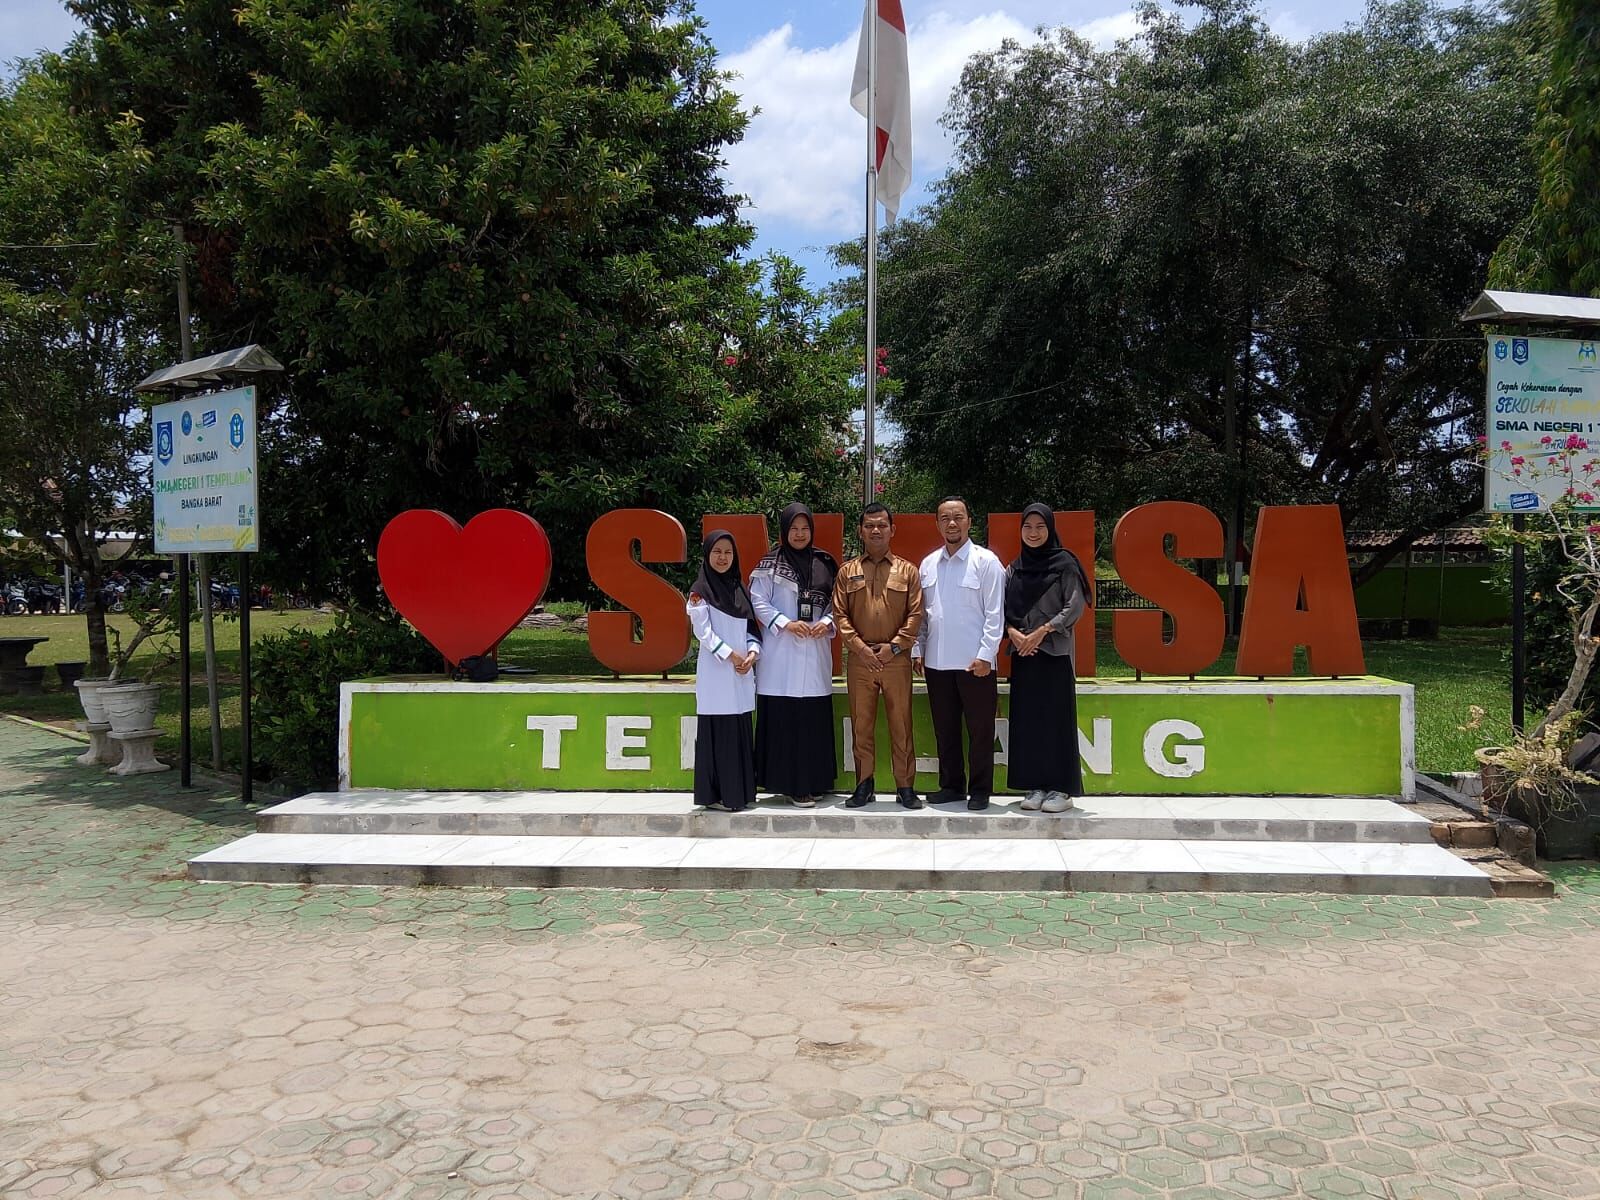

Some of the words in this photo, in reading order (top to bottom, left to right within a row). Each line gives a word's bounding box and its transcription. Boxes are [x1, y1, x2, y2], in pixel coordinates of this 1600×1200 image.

[1497, 381, 1518, 394] Cegah
[1521, 382, 1557, 393] Kekerasan
[1558, 384, 1583, 396] dengan
[1496, 421, 1529, 431] SMA
[1587, 422, 1593, 432] 1
[183, 451, 218, 465] LINGKUNGAN
[156, 480, 171, 493] SMA
[173, 476, 199, 492] NEGERI
[181, 498, 203, 509] BANGKA
[205, 496, 223, 507] BARAT
